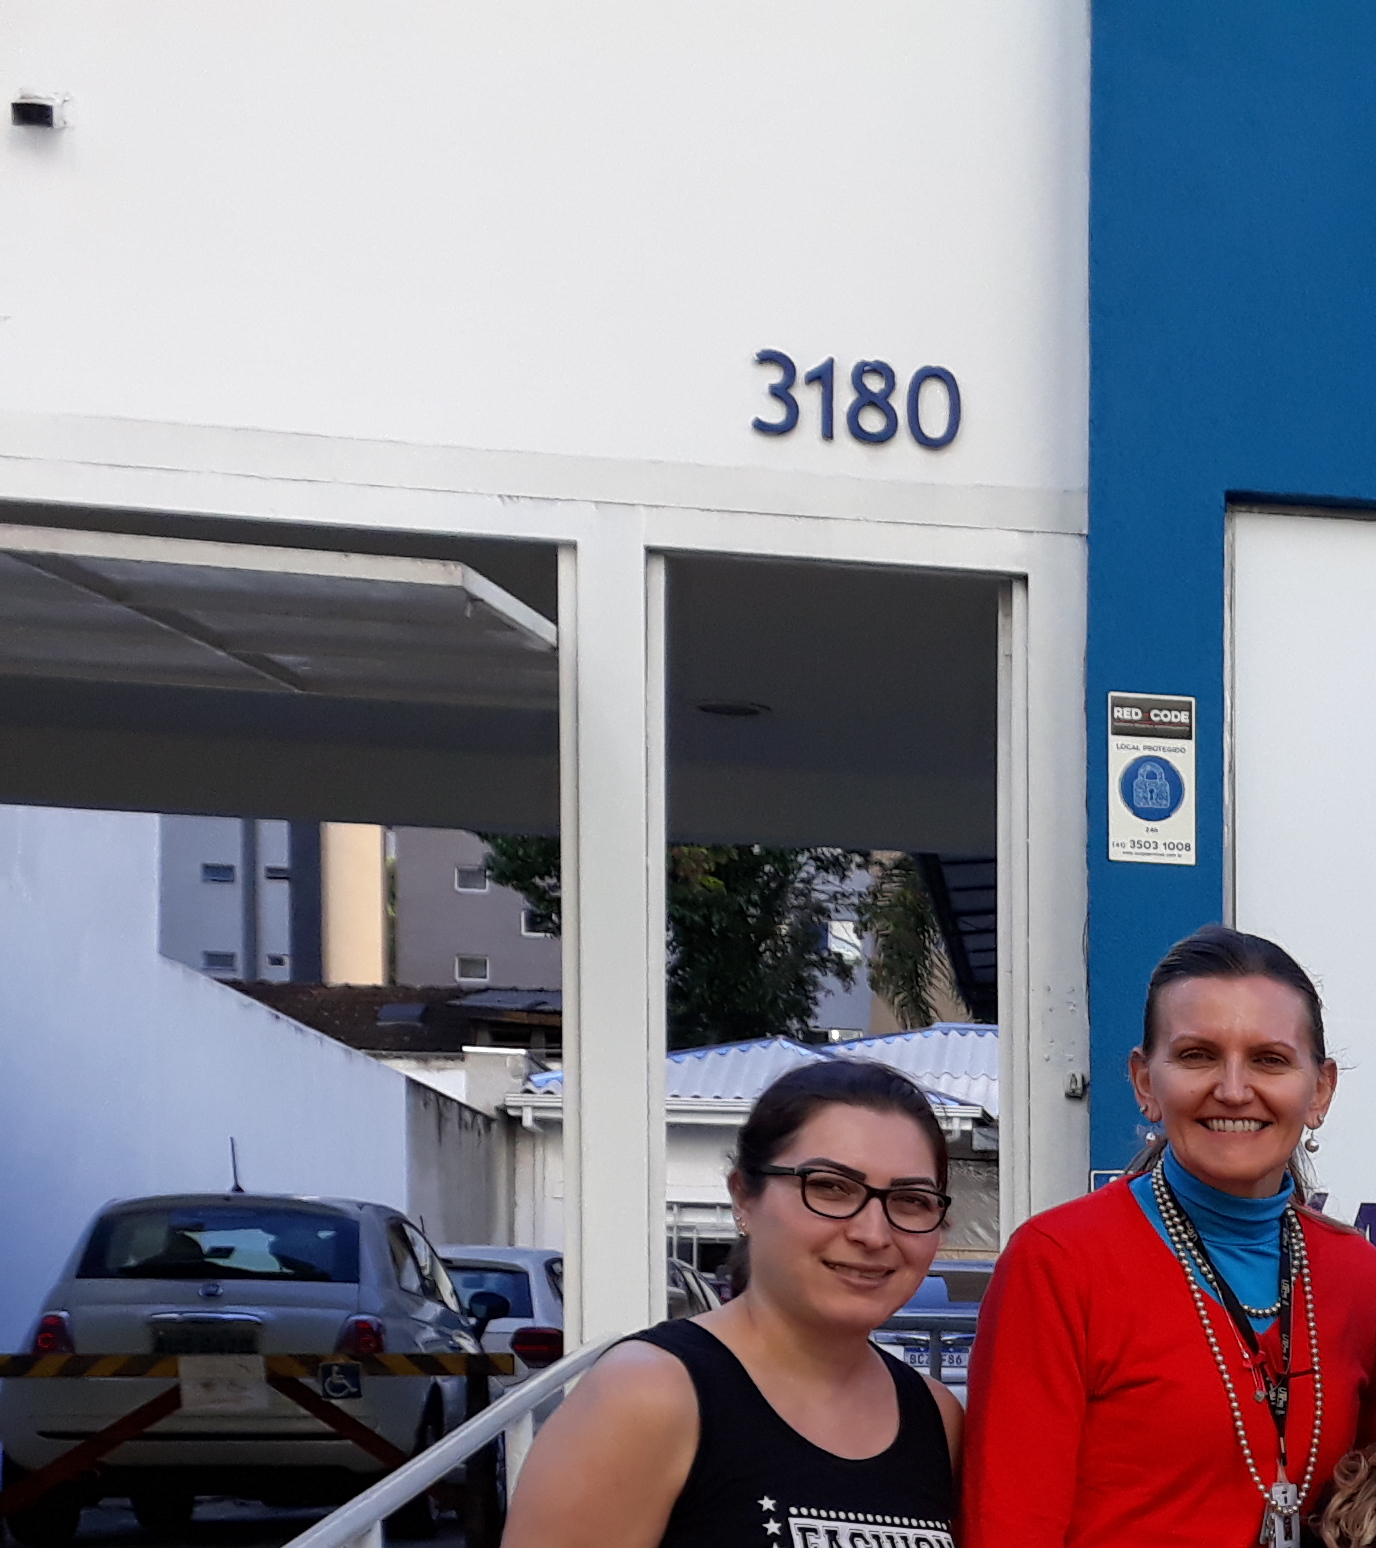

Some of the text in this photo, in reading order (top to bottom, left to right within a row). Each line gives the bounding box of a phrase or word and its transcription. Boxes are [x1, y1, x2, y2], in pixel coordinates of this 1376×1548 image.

[752, 349, 961, 449] 3180
[1113, 706, 1190, 724] RED CODE
[1116, 743, 1140, 751] LOCAL
[1129, 839, 1159, 850] 3503
[1162, 841, 1192, 851] 1008
